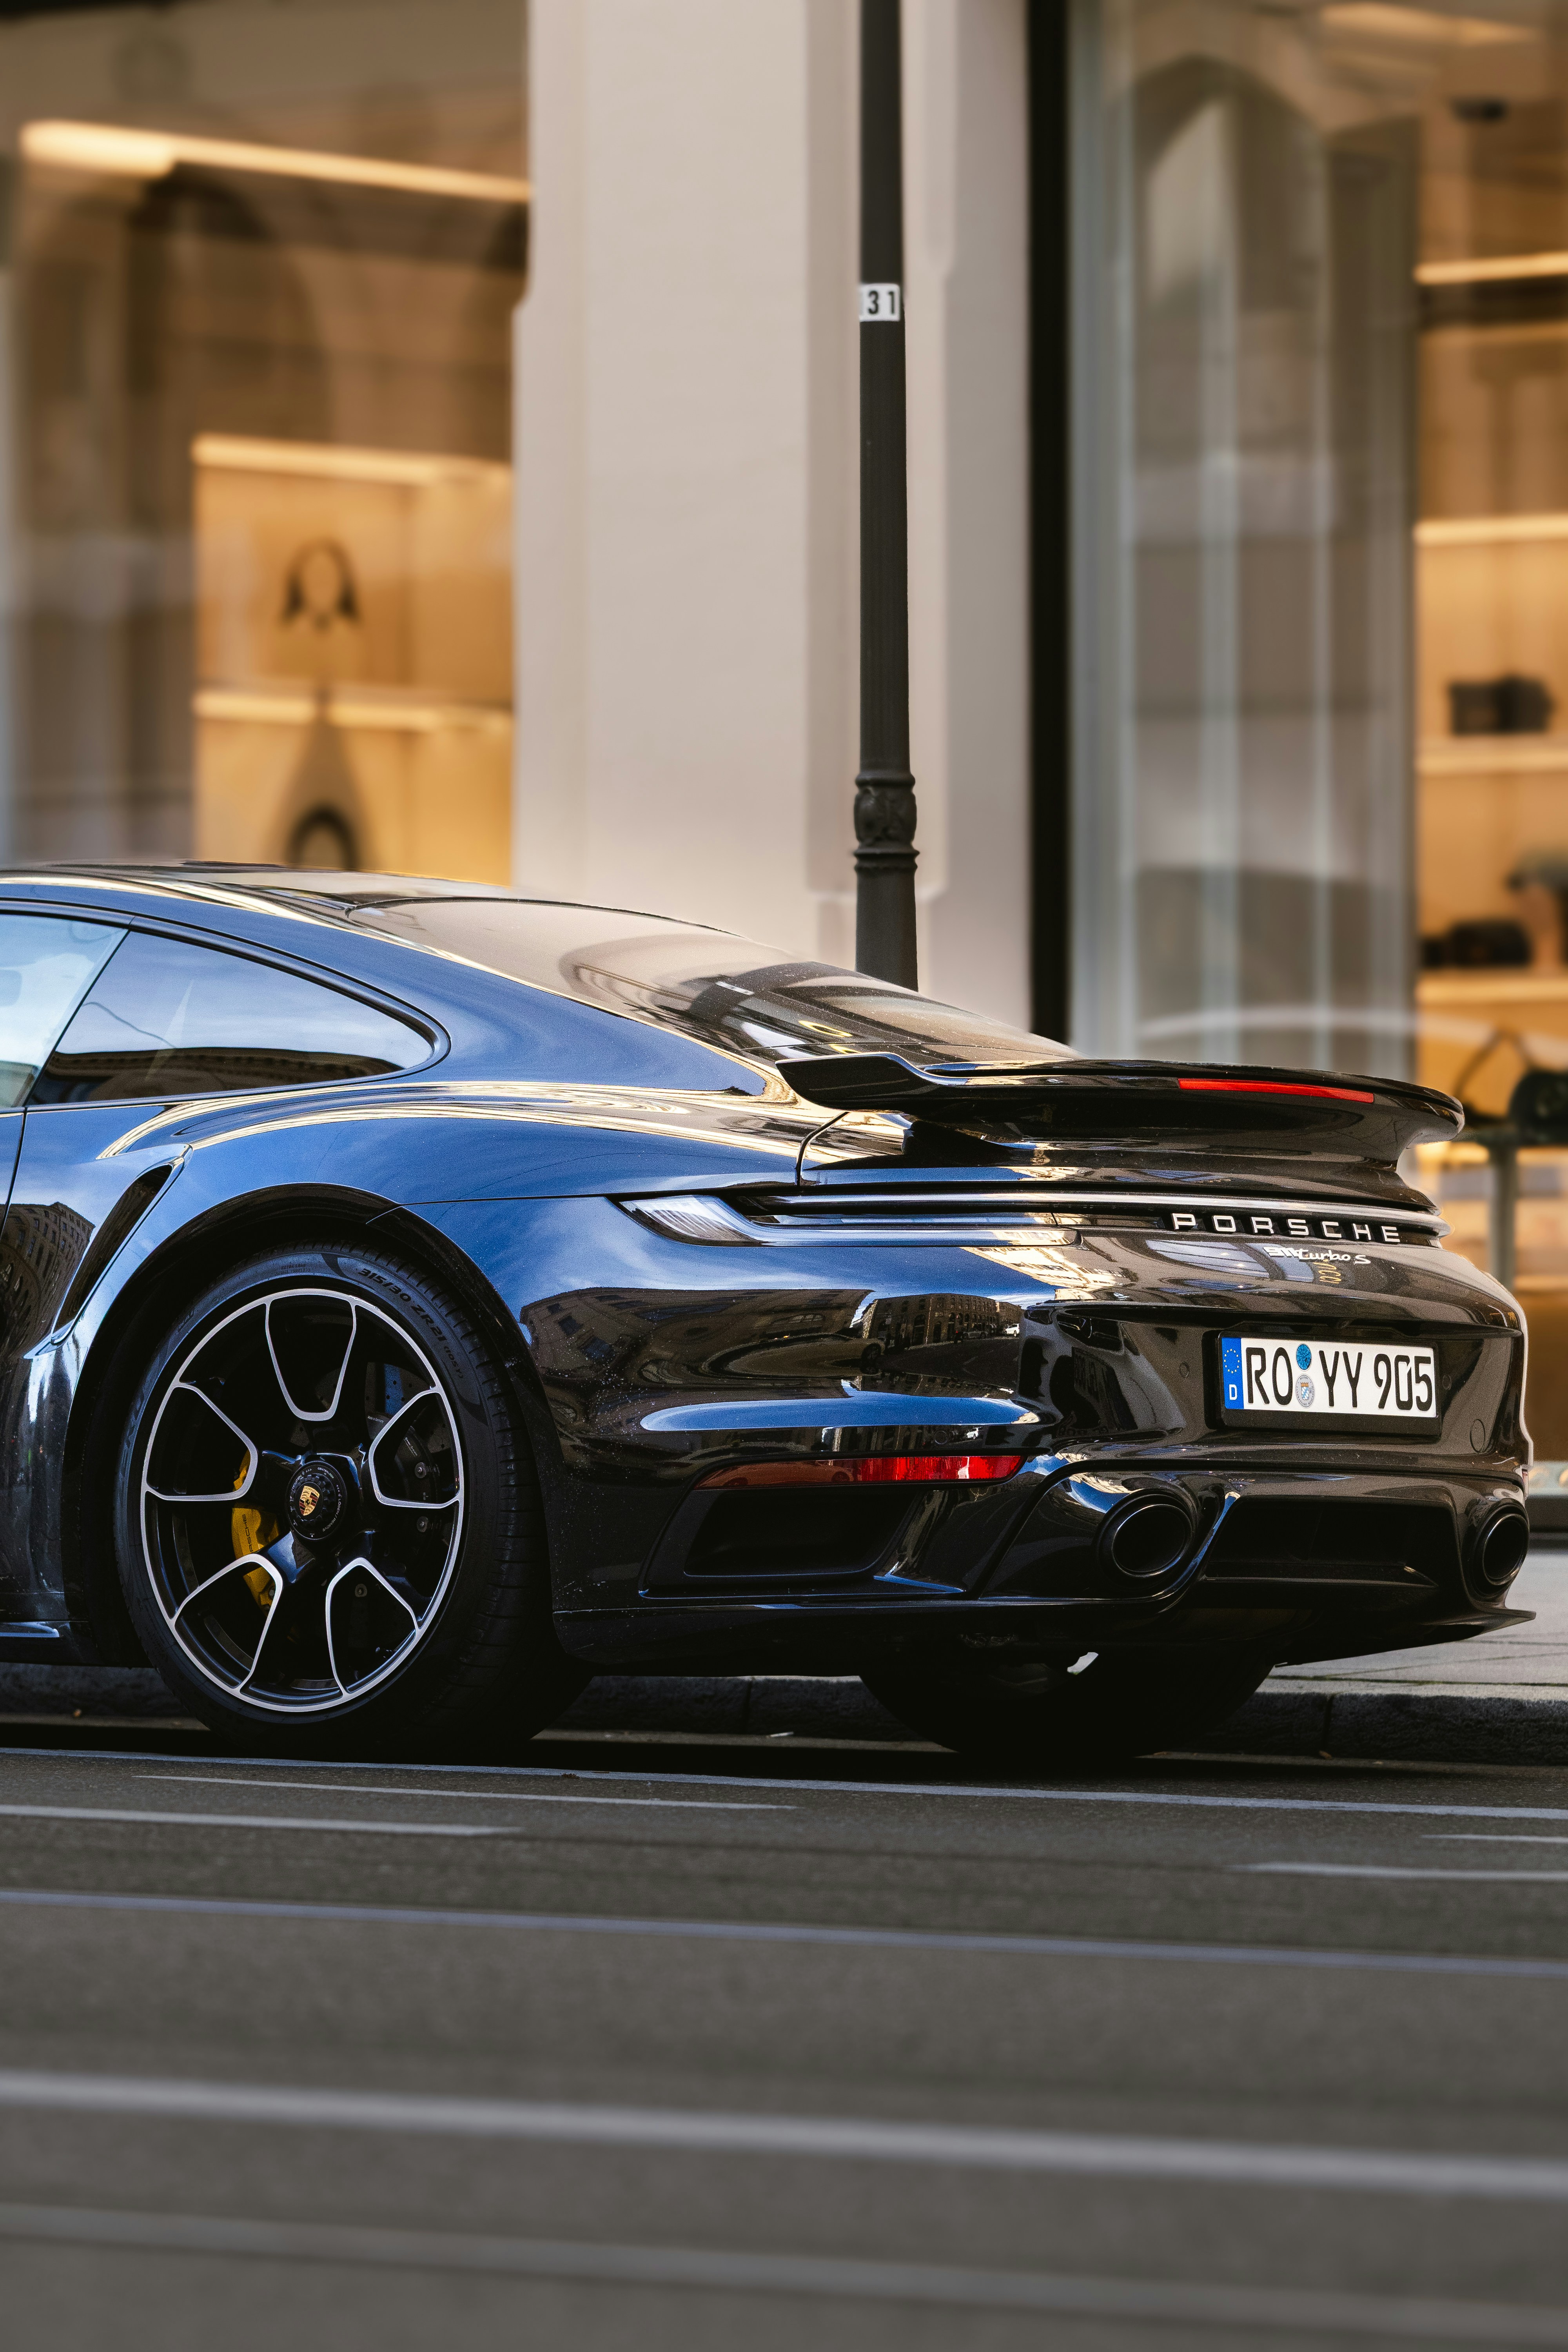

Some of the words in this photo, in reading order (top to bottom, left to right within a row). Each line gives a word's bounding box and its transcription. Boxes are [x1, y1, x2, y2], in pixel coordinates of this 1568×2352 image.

[868, 290, 895, 314] 31
[1171, 1213, 1401, 1243] PORSCHE
[1296, 1248, 1351, 1261] turbo
[1354, 1254, 1371, 1264] S
[358, 1268, 412, 1302] 315/30
[411, 1304, 447, 1341] ZR21
[1229, 1384, 1238, 1400] D
[1245, 1347, 1293, 1406] RO
[1319, 1350, 1363, 1408] YY
[1373, 1353, 1433, 1412] 905
[242, 1514, 253, 1552] RSCHE
